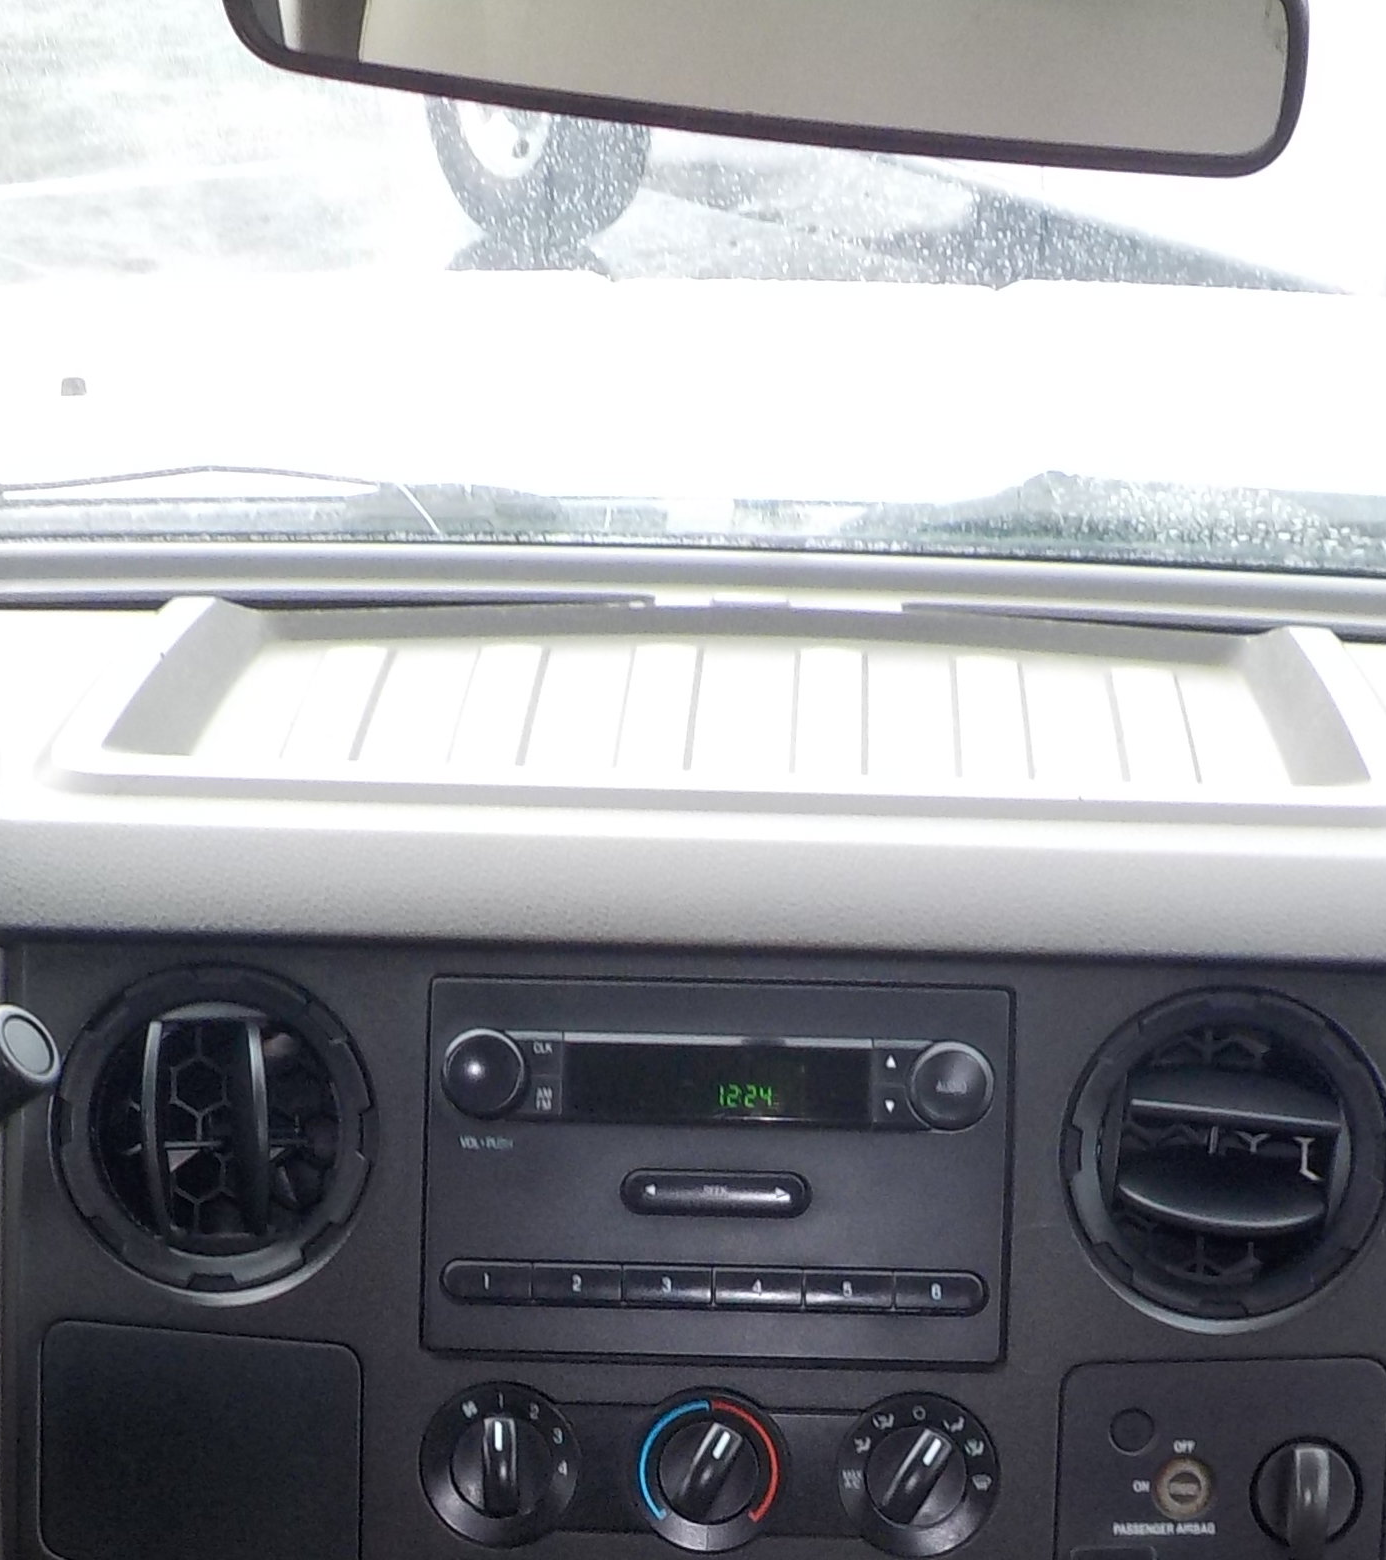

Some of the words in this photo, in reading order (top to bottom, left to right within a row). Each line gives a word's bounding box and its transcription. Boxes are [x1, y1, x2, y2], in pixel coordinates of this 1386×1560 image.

[571, 1273, 582, 1292] 2
[662, 1275, 672, 1293] 3
[751, 1278, 762, 1296] 4
[842, 1280, 853, 1298] 5
[930, 1282, 942, 1301] 6
[1173, 1439, 1196, 1454] OFF
[1132, 1480, 1151, 1493] ON
[1113, 1522, 1174, 1536] PASSENGER
[1176, 1522, 1216, 1535] AIRBAG
